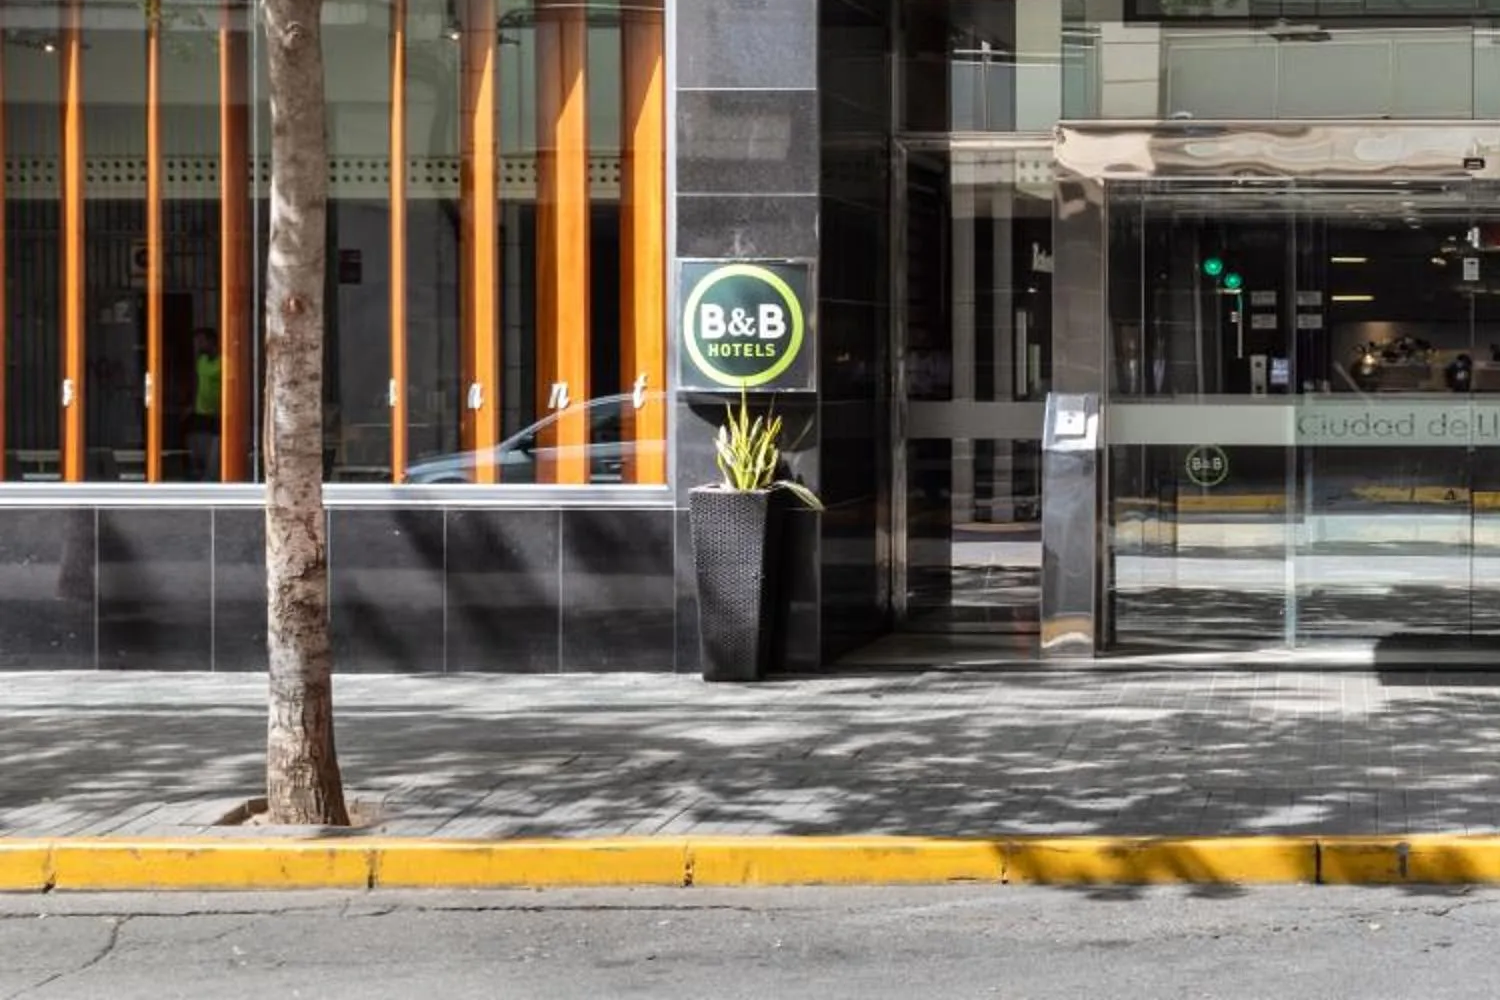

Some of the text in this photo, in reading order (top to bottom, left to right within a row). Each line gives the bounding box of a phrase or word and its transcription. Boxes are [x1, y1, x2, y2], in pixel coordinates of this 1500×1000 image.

[700, 303, 786, 339] B&B
[708, 343, 776, 357] HOTELS
[1296, 412, 1415, 437] Ciudad
[1427, 412, 1469, 437] de
